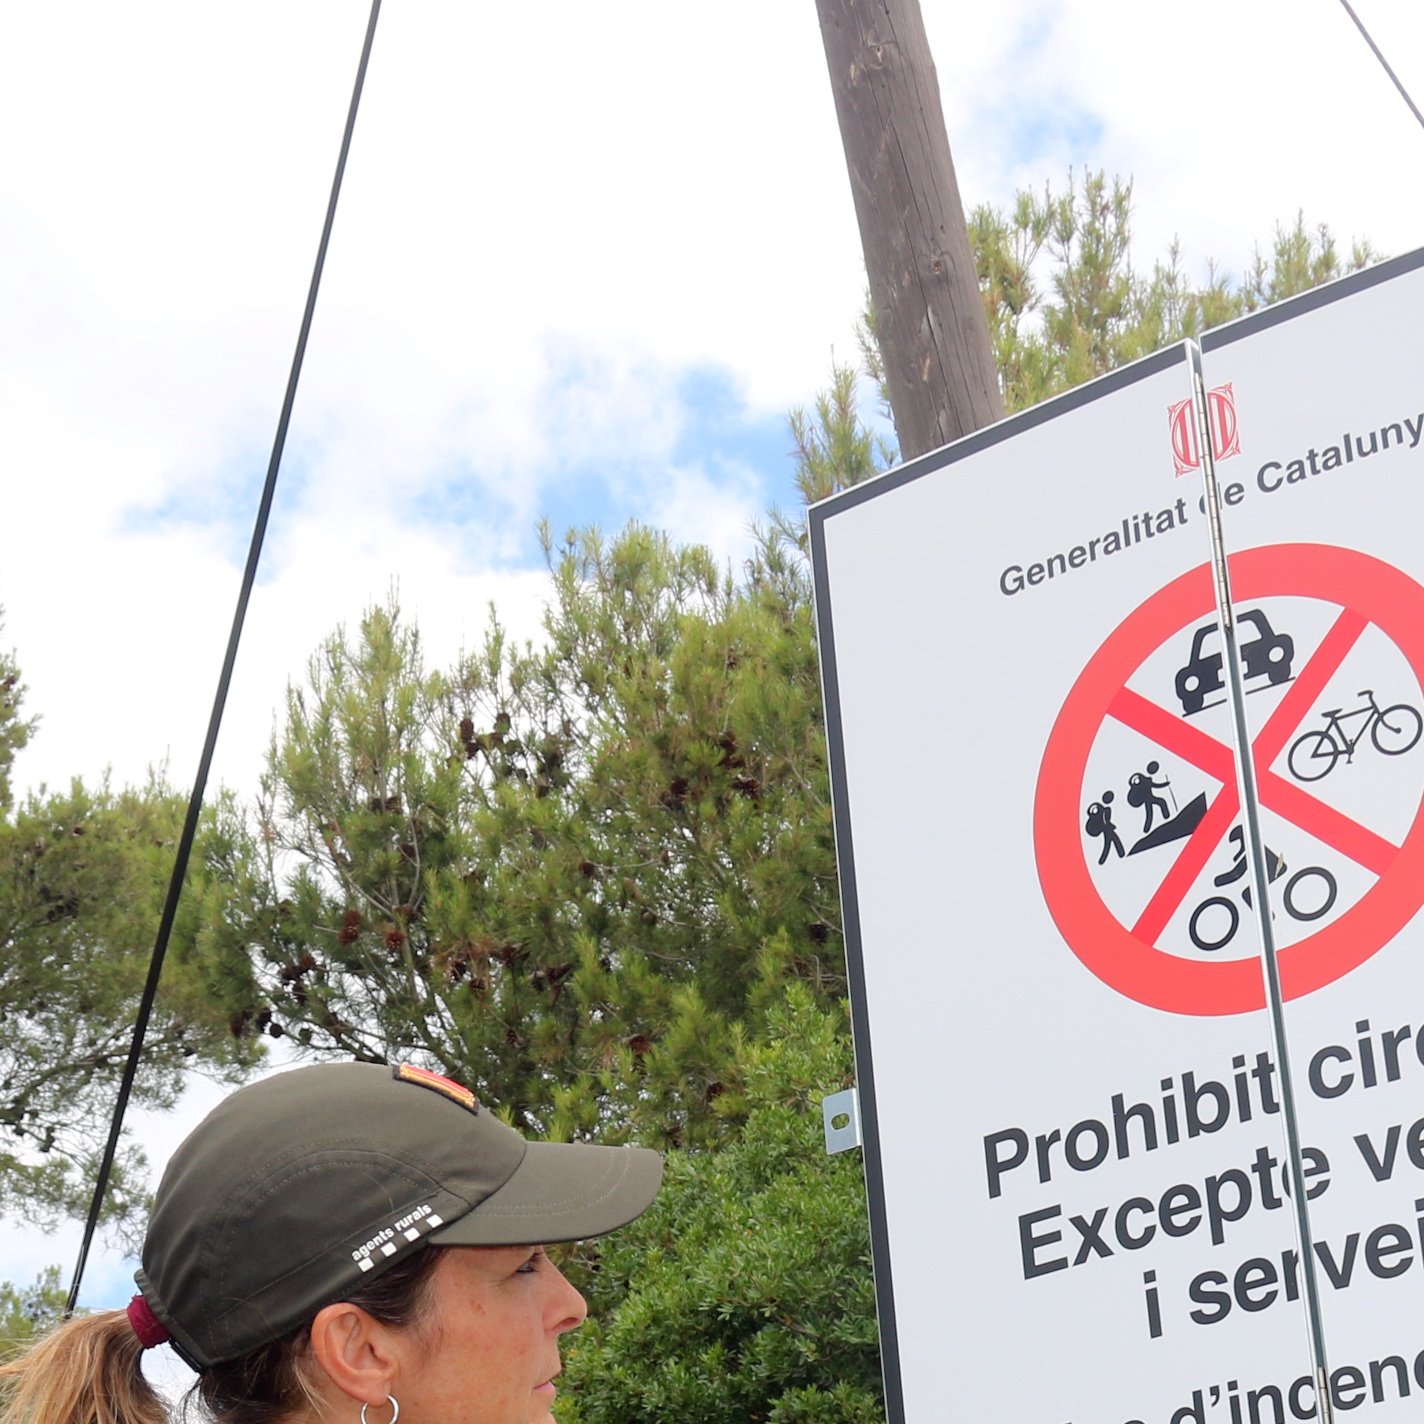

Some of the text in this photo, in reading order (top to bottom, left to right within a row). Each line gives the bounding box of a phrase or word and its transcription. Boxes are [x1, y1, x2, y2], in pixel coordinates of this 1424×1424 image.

[998, 498, 1188, 597] Generalitat
[983, 1051, 1281, 1199] Prohibit
[351, 1204, 432, 1261] agents rurals
[1018, 1147, 1331, 1280] Excepte
[1144, 1270, 1163, 1339] i
